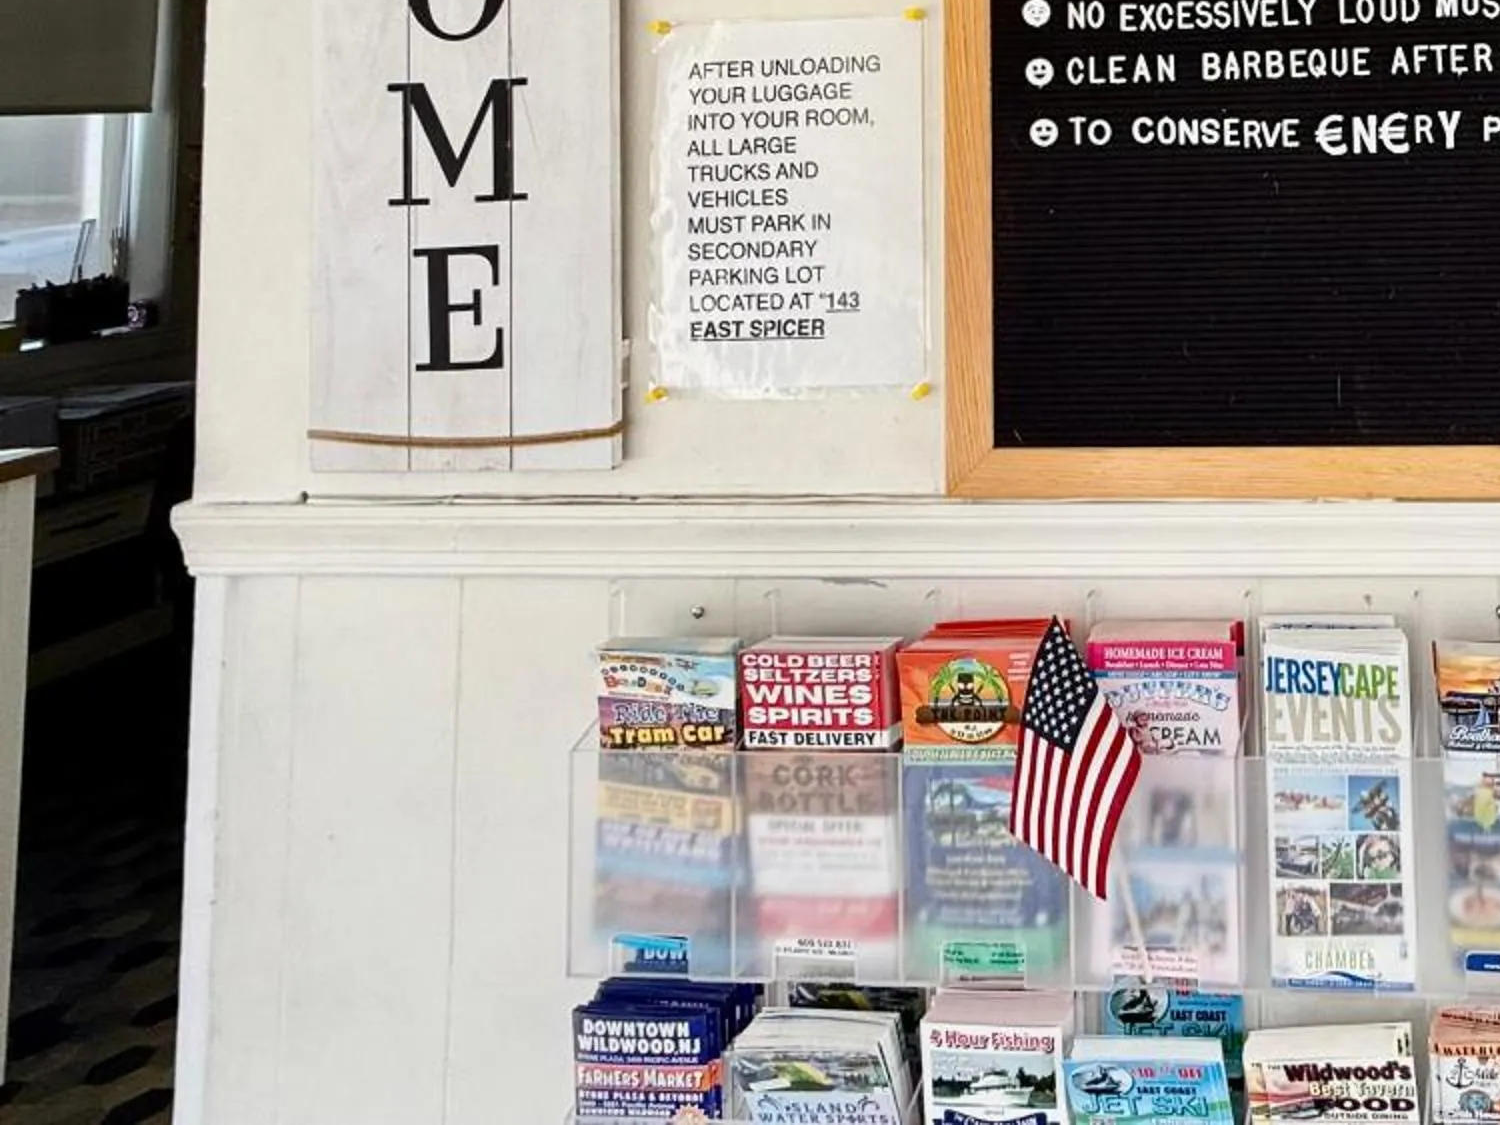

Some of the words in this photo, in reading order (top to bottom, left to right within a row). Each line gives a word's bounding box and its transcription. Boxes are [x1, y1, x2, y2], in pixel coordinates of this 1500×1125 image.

[688, 61, 753, 79] AFTER
[761, 55, 881, 76] UNLOADING
[689, 87, 745, 105] YOUR
[752, 83, 852, 103] LUGGAGE
[688, 113, 735, 131] INTO
[741, 111, 799, 129] YOUR
[1068, 116, 1113, 146] TO
[1131, 116, 1300, 149] CONSERVE
[688, 139, 723, 156] ALL
[729, 137, 797, 155] LARGE
[688, 164, 771, 183] TRUCKS
[776, 162, 818, 180] AND
[688, 189, 788, 207] VEHICLES
[688, 217, 746, 234] MUST
[751, 214, 805, 233] PARK
[812, 214, 831, 230] IN
[688, 241, 818, 261] SECONDARY
[689, 267, 779, 287] PARKING
[786, 266, 825, 284] LOT
[689, 294, 784, 313] LOCATED
[789, 293, 813, 310] AT
[690, 321, 744, 340] EAST
[750, 319, 825, 339] SPICER
[742, 655, 803, 668] COLD
[808, 655, 871, 668] BEER
[1104, 647, 1164, 660] HOMEMADE
[1168, 648, 1184, 659] ICE
[1187, 648, 1223, 659] CREAM
[742, 668, 872, 683] SELTZERS
[746, 684, 872, 705] WINES
[748, 707, 873, 726] SPIRITS
[1268, 693, 1401, 744] EVENTS
[609, 725, 675, 745] Tram
[683, 725, 725, 743] Car
[749, 731, 787, 746] FAST
[794, 731, 876, 747] DELIVERY
[773, 764, 859, 787] CORK
[583, 1018, 690, 1037] DOWNTOWN
[945, 1030, 990, 1049] Hour
[991, 1033, 1055, 1054] Fishing
[1284, 1061, 1412, 1083] Wildwood's
[1309, 1083, 1349, 1096] Best
[1313, 1098, 1415, 1111] FOOD
[758, 1113, 820, 1124] WATER
[826, 1114, 888, 1124] SPORTS
